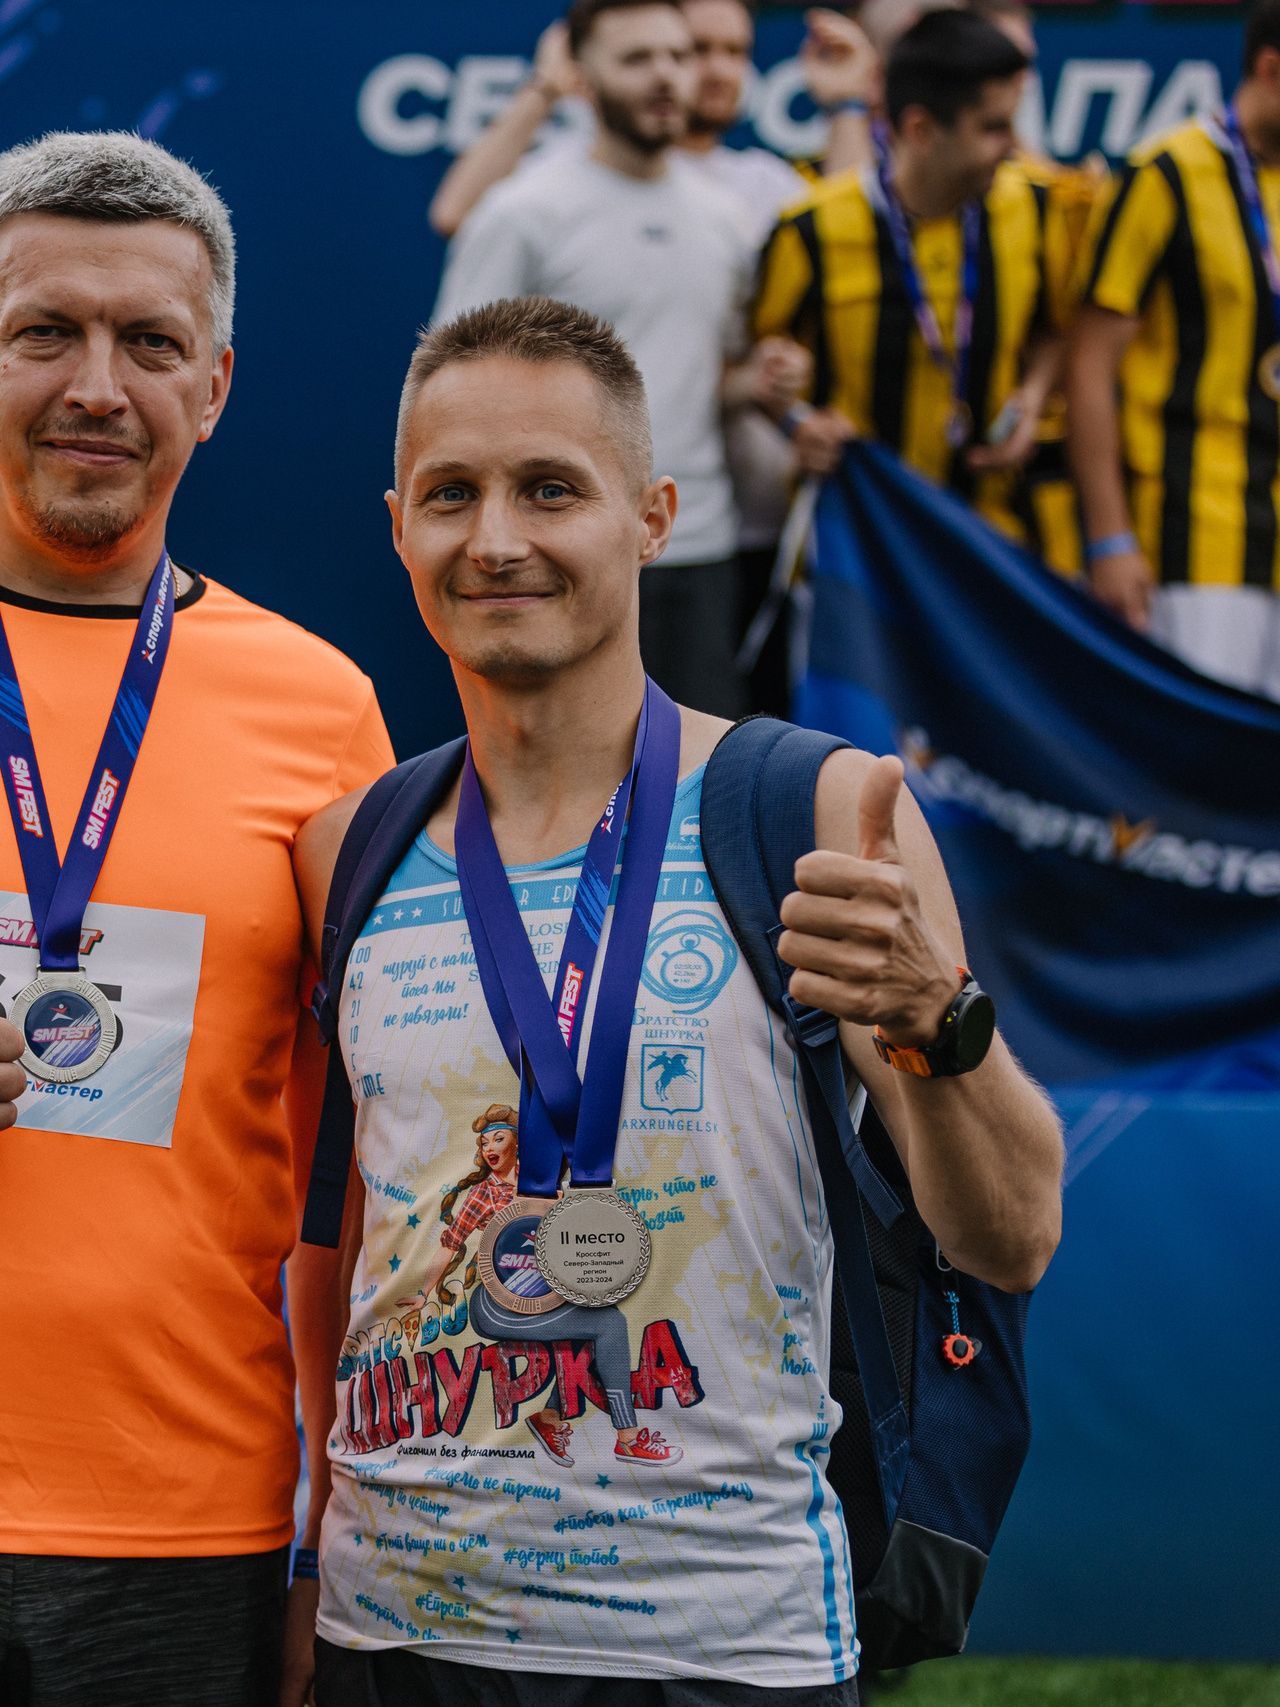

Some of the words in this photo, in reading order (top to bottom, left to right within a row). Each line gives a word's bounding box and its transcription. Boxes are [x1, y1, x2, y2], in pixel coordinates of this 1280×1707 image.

[8, 755, 33, 790] SM
[91, 768, 121, 821] FEST
[16, 787, 44, 838] FEST
[82, 813, 106, 850] SM
[349, 946, 372, 965] 100
[349, 971, 364, 991] 42
[401, 982, 429, 998] пока
[431, 980, 456, 994] мы
[559, 962, 585, 1018] FEST
[350, 999, 361, 1019] 21
[383, 1014, 398, 1028] не
[400, 1002, 470, 1029] завязали!
[31, 1026, 59, 1043] SM
[57, 1024, 96, 1042] FEST
[349, 1025, 360, 1045] 10
[644, 1028, 705, 1041] ШНУРКА
[621, 1118, 719, 1133] ARXRUNGELSK
[662, 1176, 696, 1197] что
[699, 1174, 719, 1189] не
[575, 1232, 626, 1245] место
[563, 1259, 625, 1267] Северо-Западный
[575, 1250, 611, 1259] Кроссфит
[576, 1276, 613, 1284] 2023-2024
[340, 1319, 705, 1457] ШНУРКА
[396, 1443, 437, 1457] Фигачим
[440, 1444, 458, 1458] без
[461, 1445, 536, 1461] фанатизма
[483, 1476, 499, 1490] не
[617, 1504, 651, 1523] как
[652, 1481, 755, 1519] тренировку
[503, 1547, 565, 1573] #дёрну
[569, 1544, 620, 1566] топов
[607, 1595, 658, 1615] пошло
[406, 1621, 419, 1639] до
